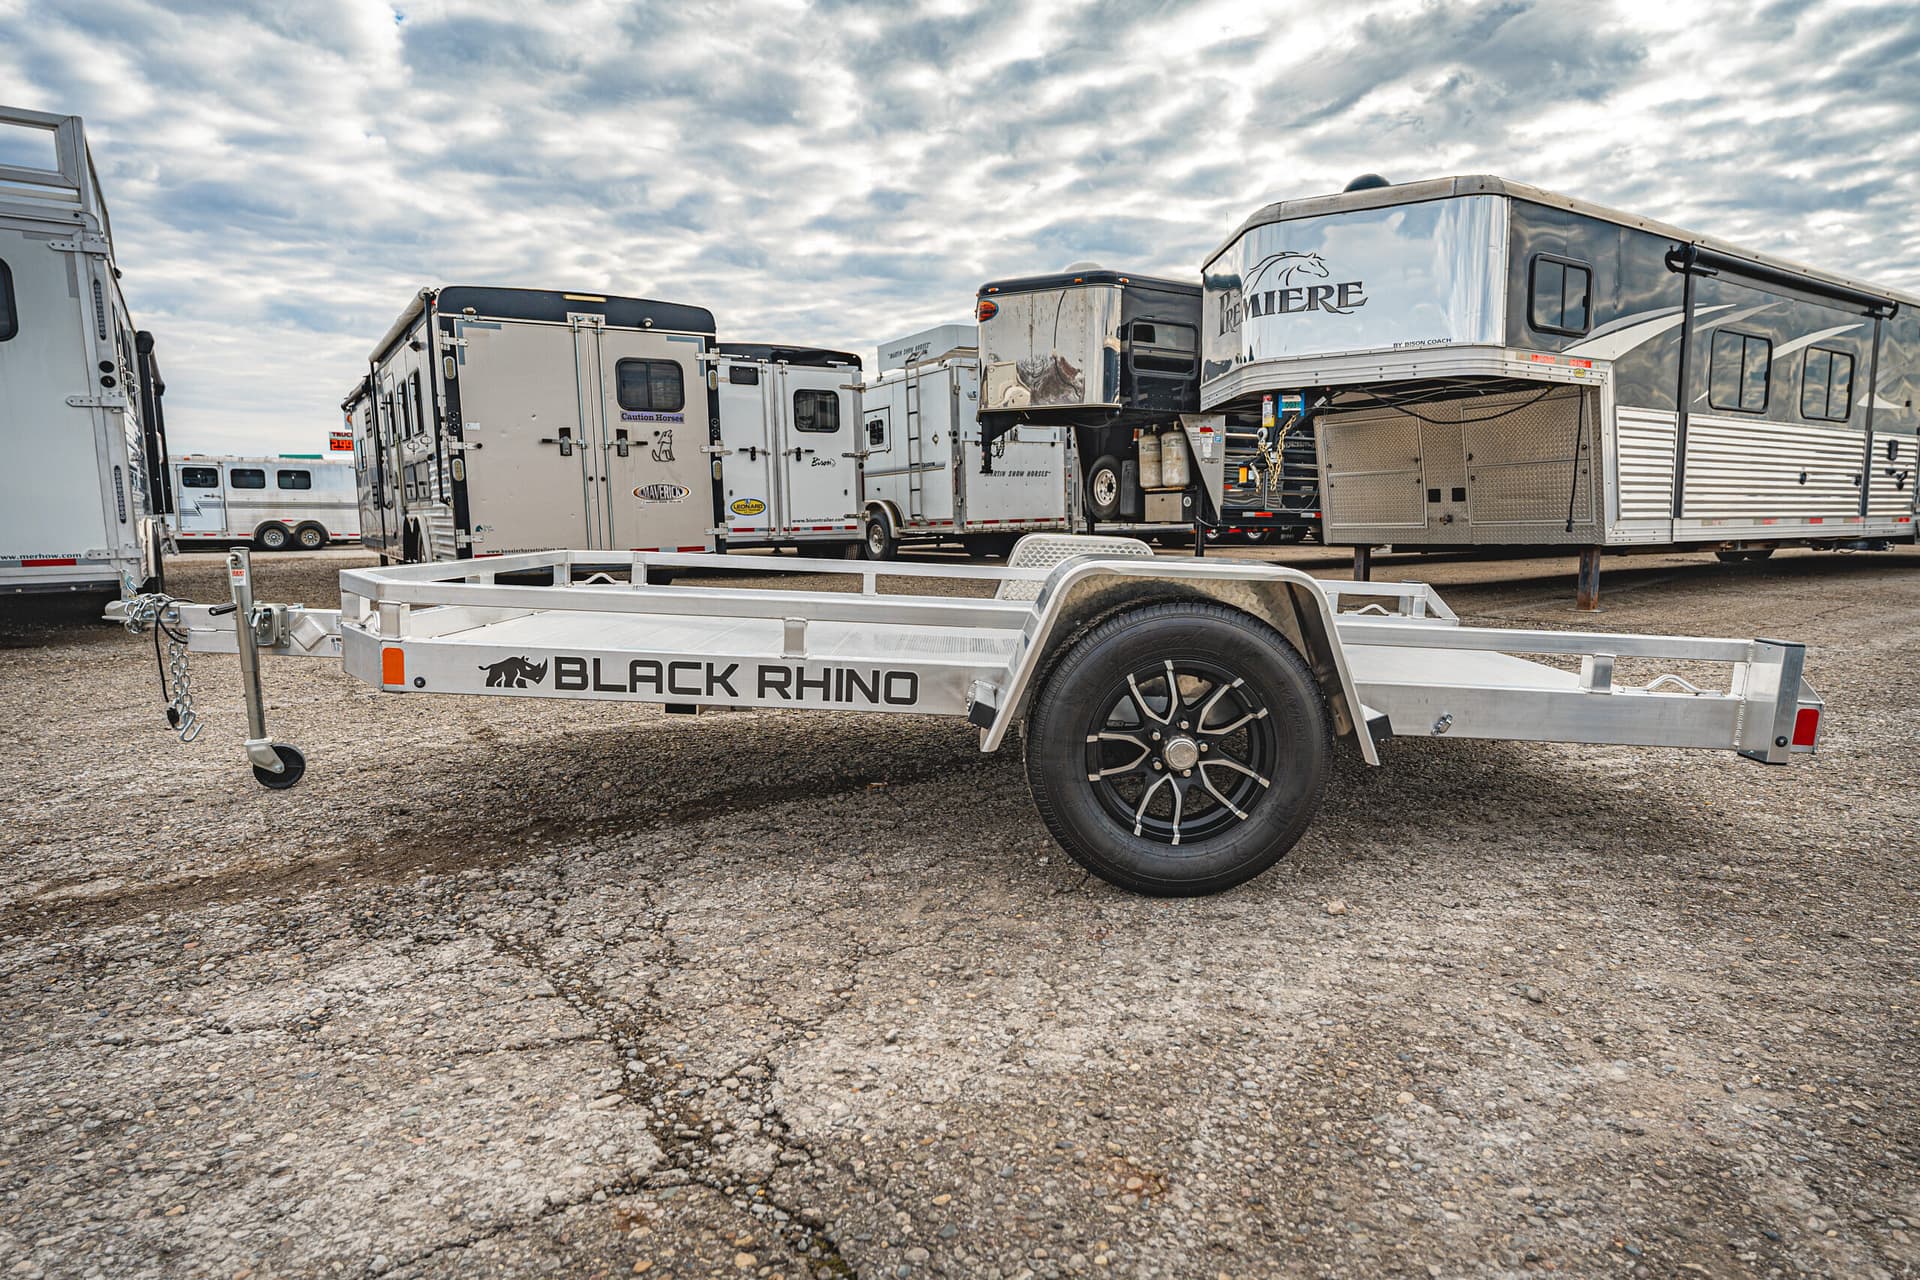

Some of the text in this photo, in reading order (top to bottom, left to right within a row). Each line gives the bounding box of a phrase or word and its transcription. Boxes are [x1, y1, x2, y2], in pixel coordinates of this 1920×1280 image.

[1218, 281, 1368, 337] PREMIERE
[621, 413, 684, 422] Caution Horses
[639, 484, 684, 500] MAVERICK
[554, 656, 918, 706] BLACK RHINO
